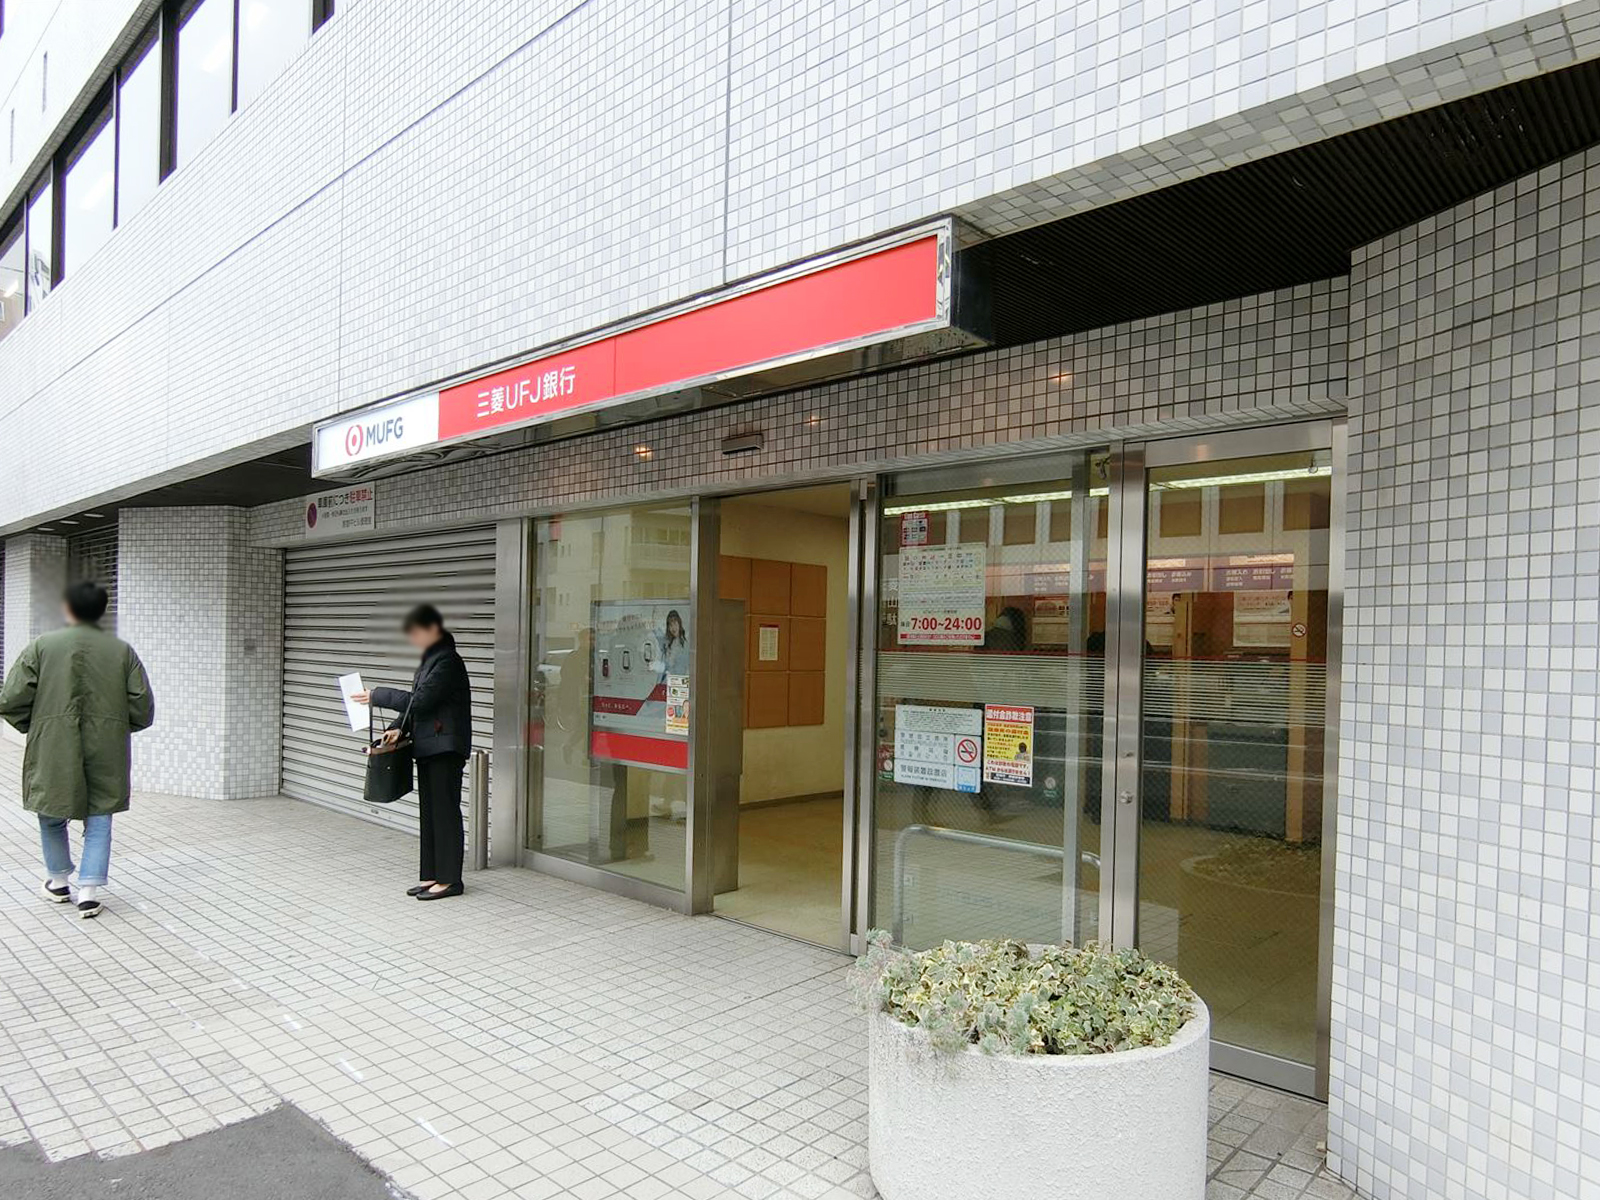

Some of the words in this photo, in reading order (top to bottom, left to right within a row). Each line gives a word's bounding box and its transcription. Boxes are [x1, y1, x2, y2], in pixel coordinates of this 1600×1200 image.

[476, 366, 576, 418] 三菱UFJ銀行
[366, 416, 404, 447] MUFG
